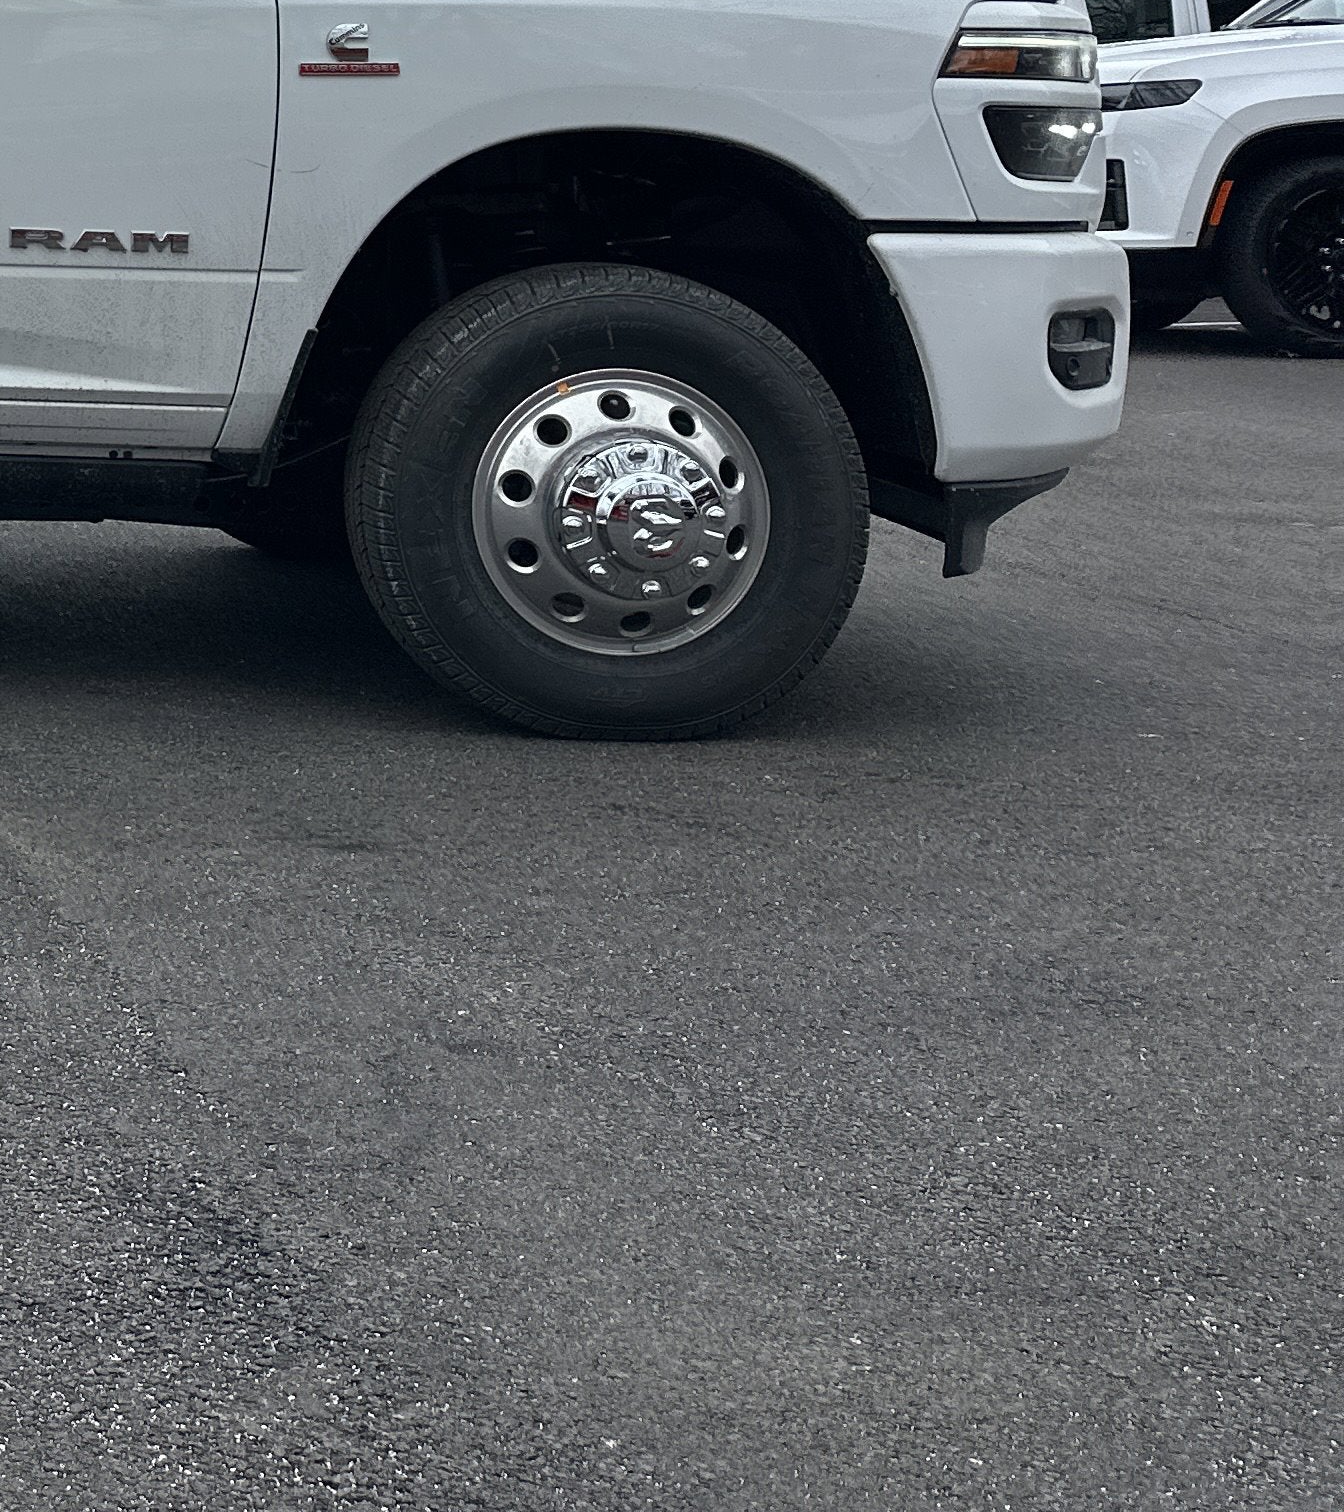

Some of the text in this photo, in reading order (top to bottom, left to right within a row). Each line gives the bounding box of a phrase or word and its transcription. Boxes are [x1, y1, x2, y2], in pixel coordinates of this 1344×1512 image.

[328, 22, 365, 46] Cummins
[302, 64, 397, 73] TURBO DIESEL
[9, 226, 190, 254] RAM
